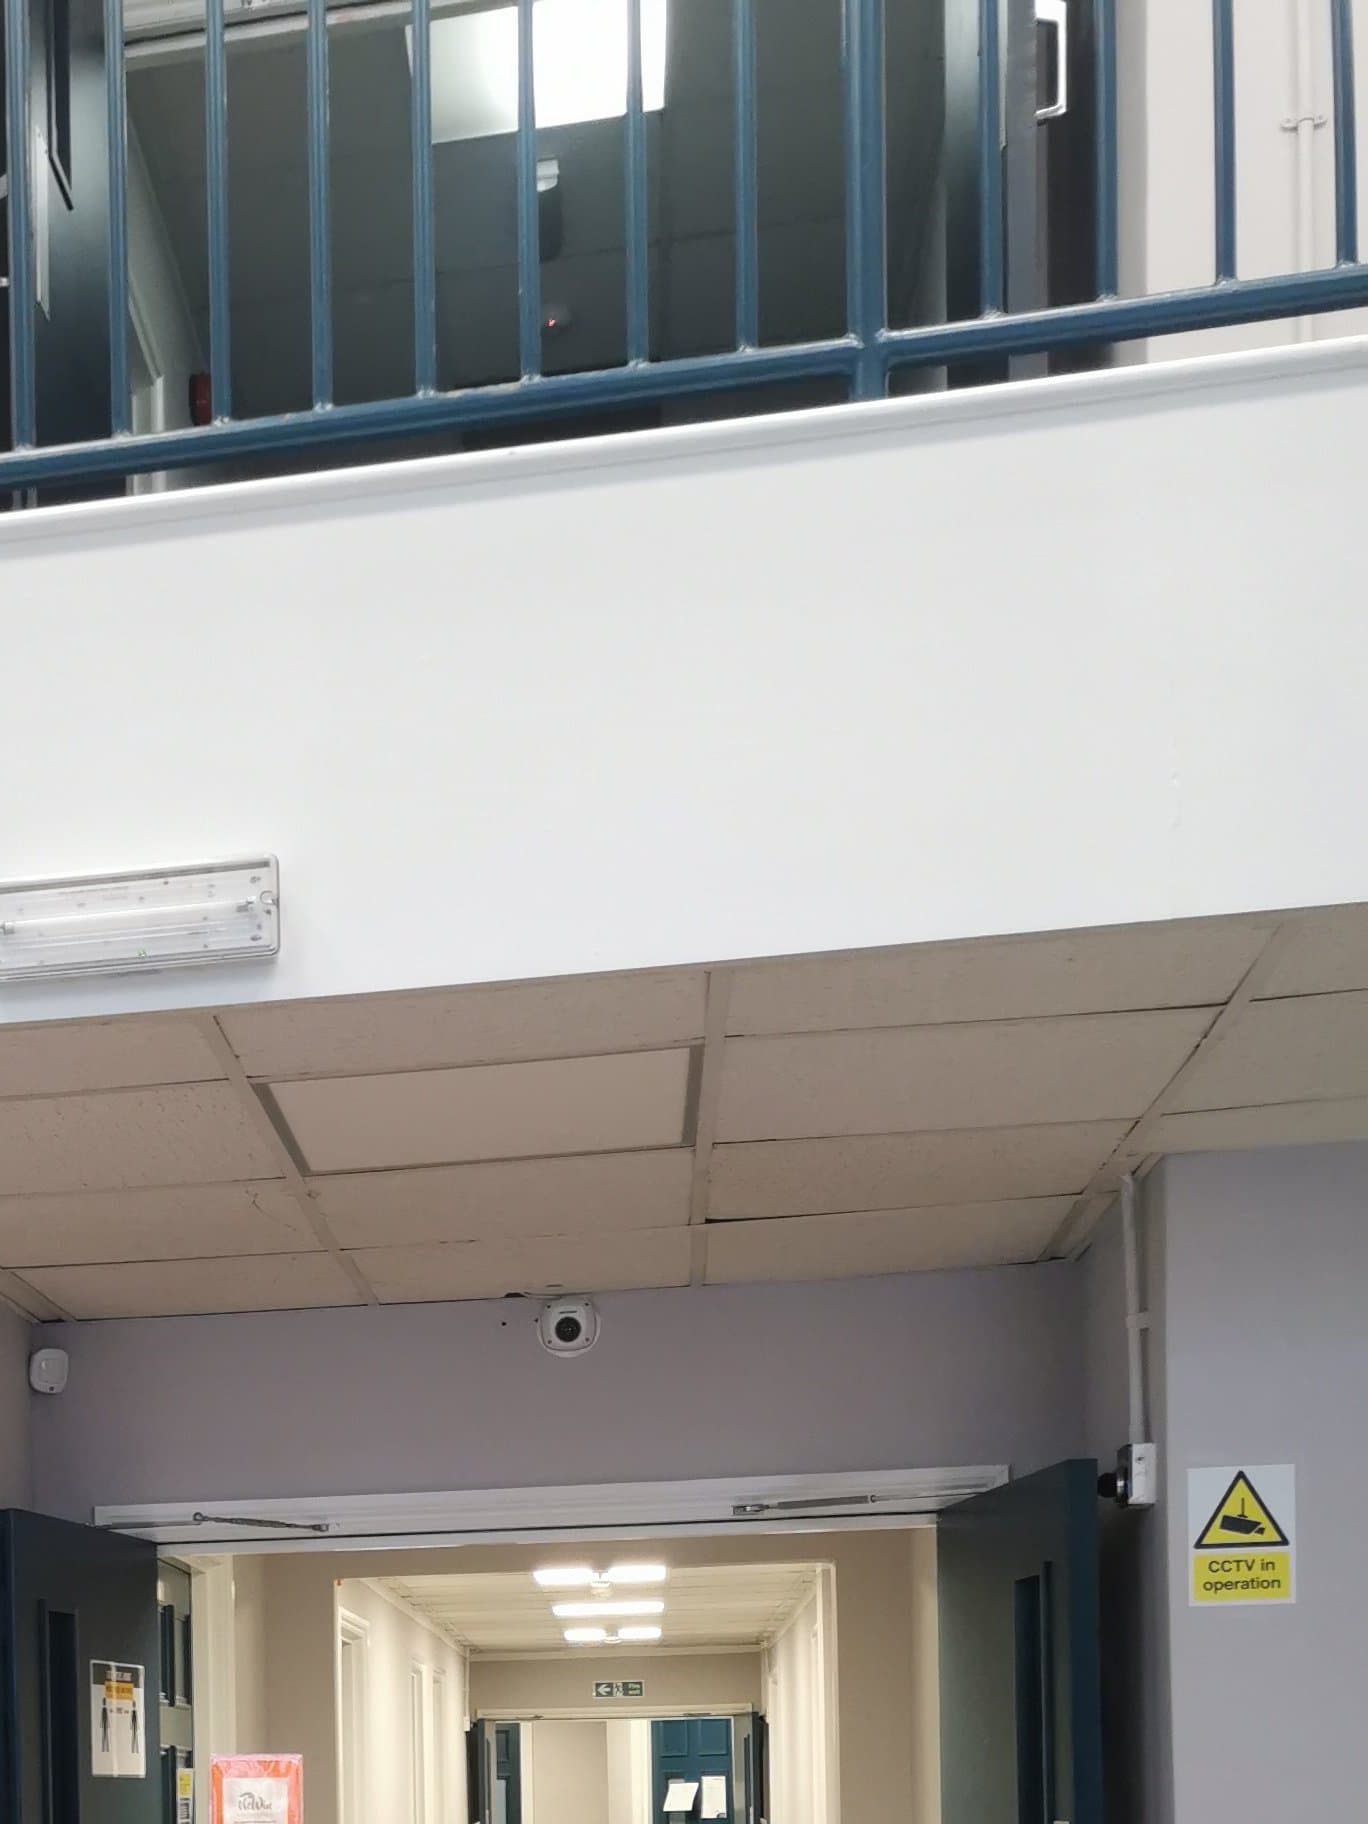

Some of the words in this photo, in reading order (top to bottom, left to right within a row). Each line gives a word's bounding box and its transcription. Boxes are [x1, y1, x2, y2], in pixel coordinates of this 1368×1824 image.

[1208, 1559, 1256, 1573] CCTV
[1260, 1559, 1276, 1571] in
[1203, 1577, 1281, 1595] operation
